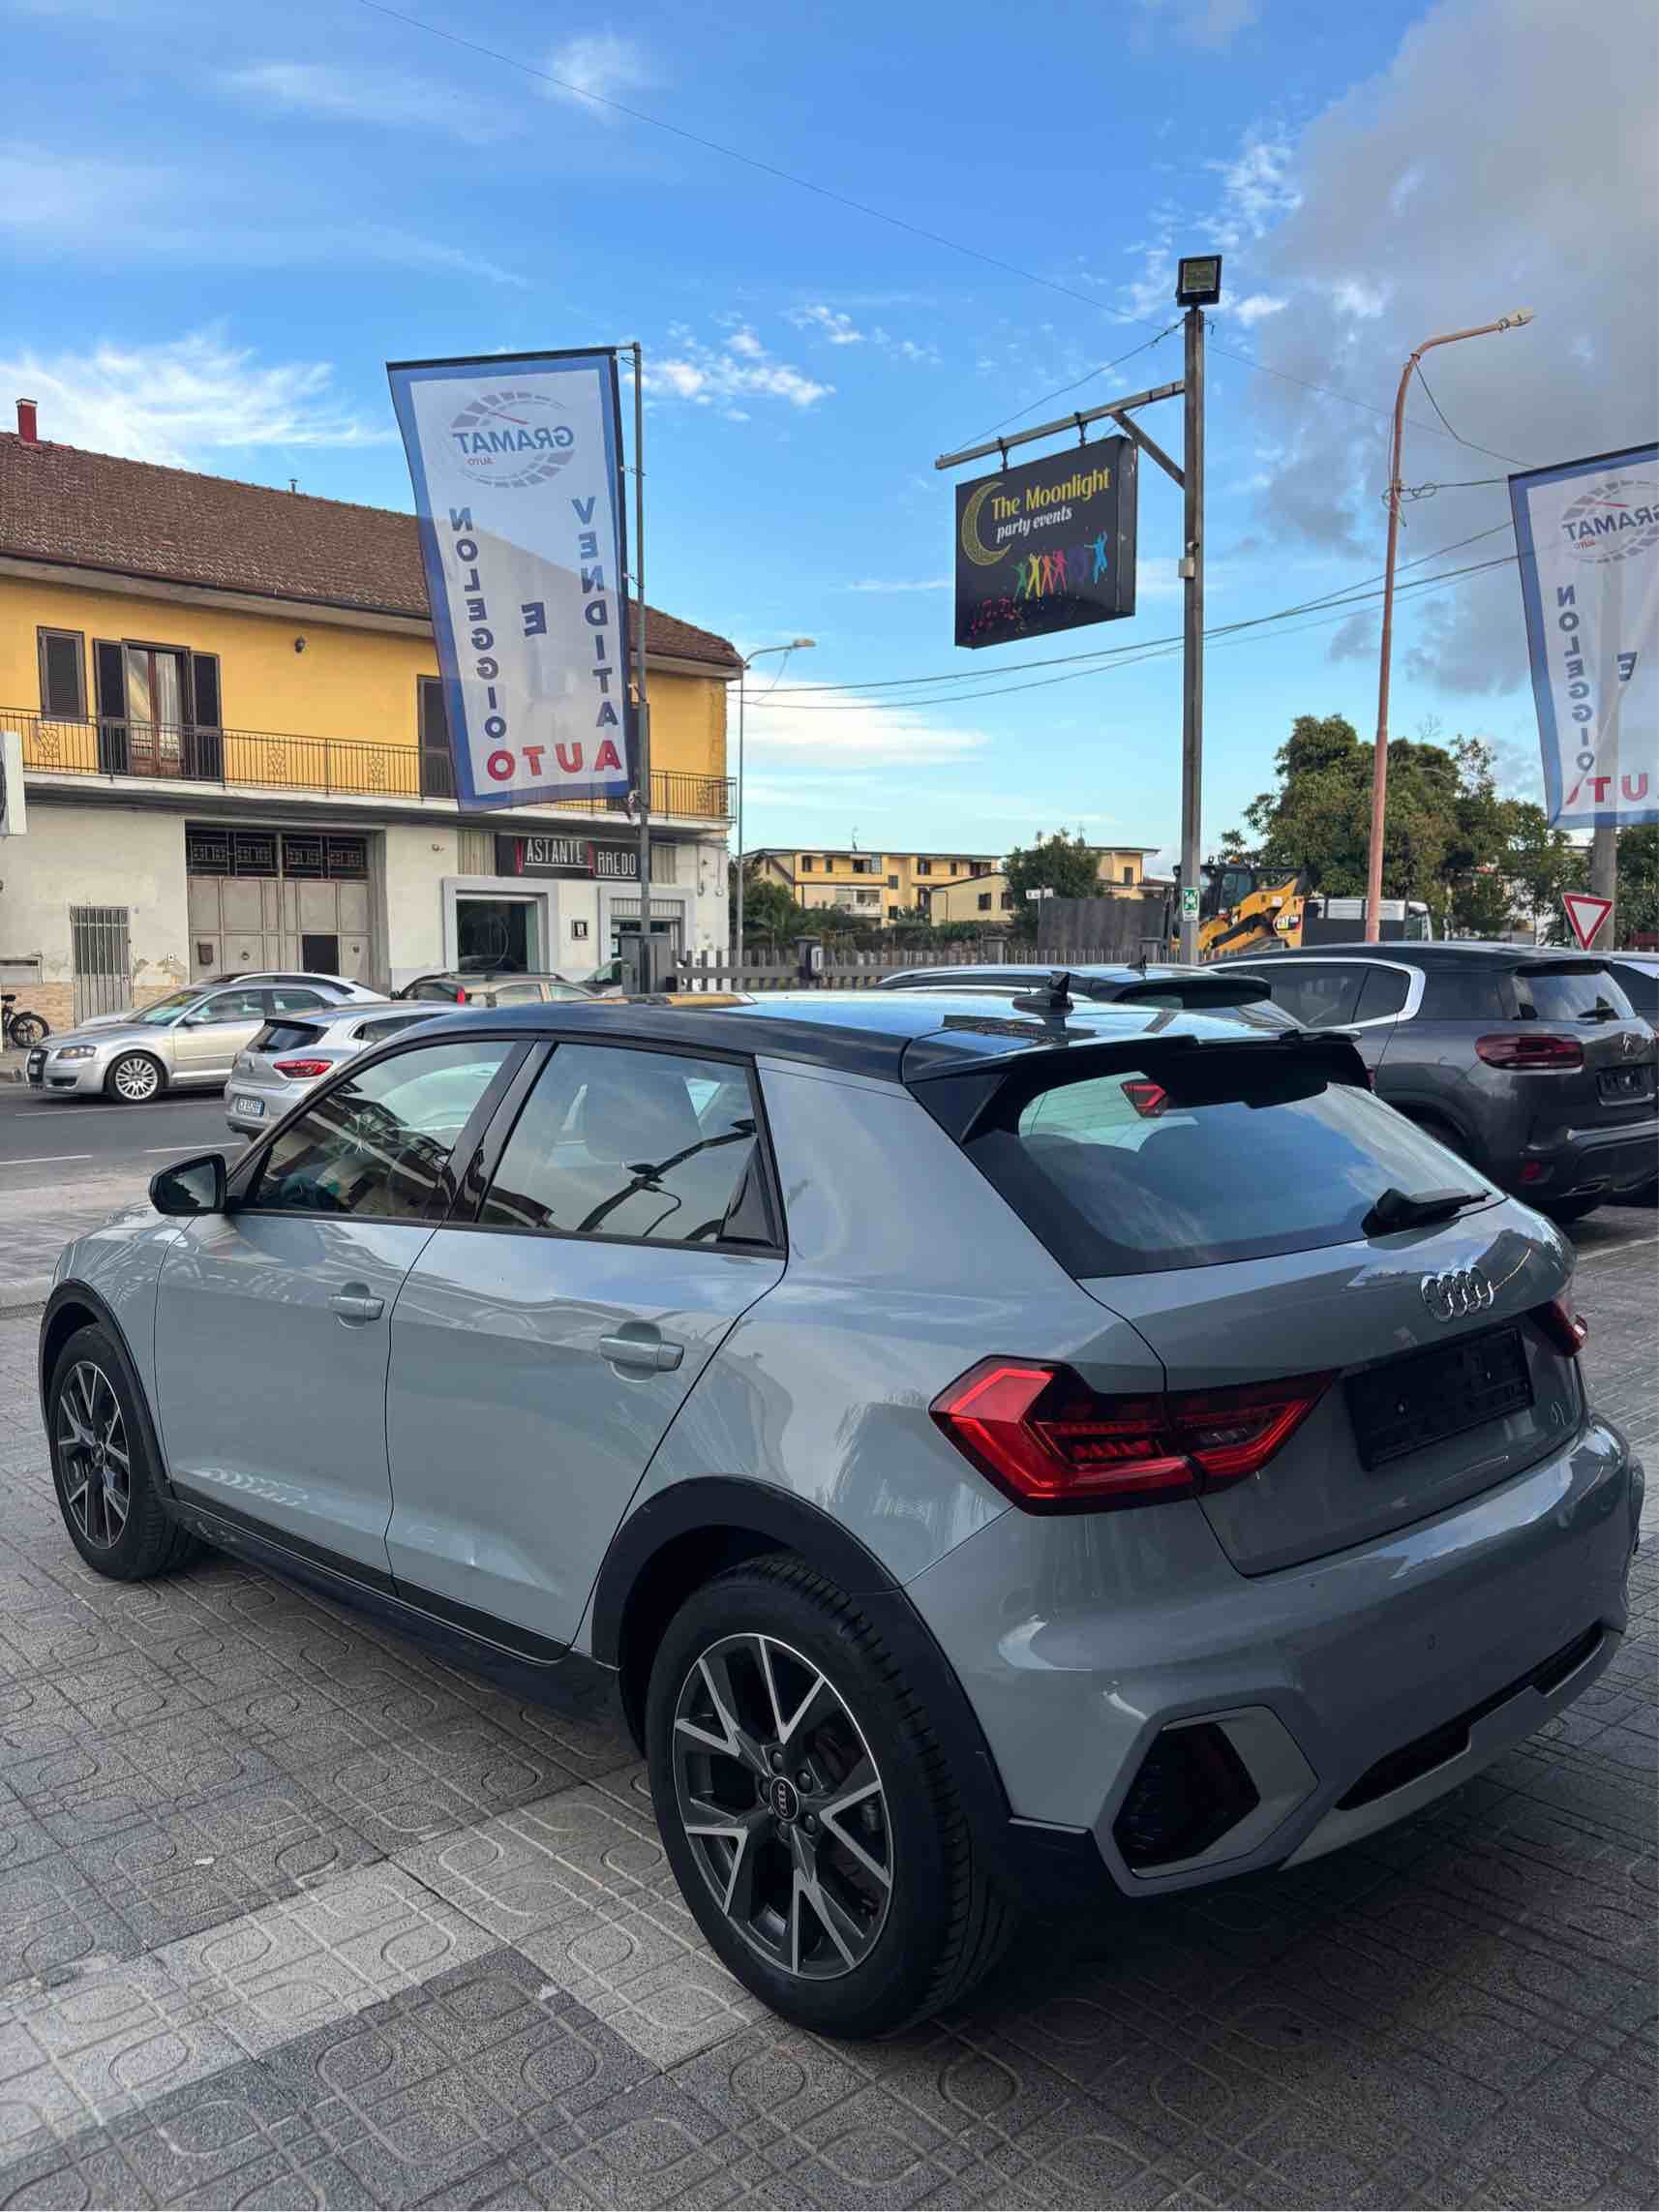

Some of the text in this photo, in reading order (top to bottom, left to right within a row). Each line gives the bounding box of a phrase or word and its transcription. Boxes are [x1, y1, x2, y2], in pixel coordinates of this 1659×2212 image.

[991, 466, 1110, 521] The Moonlight
[996, 505, 1072, 543] party events
